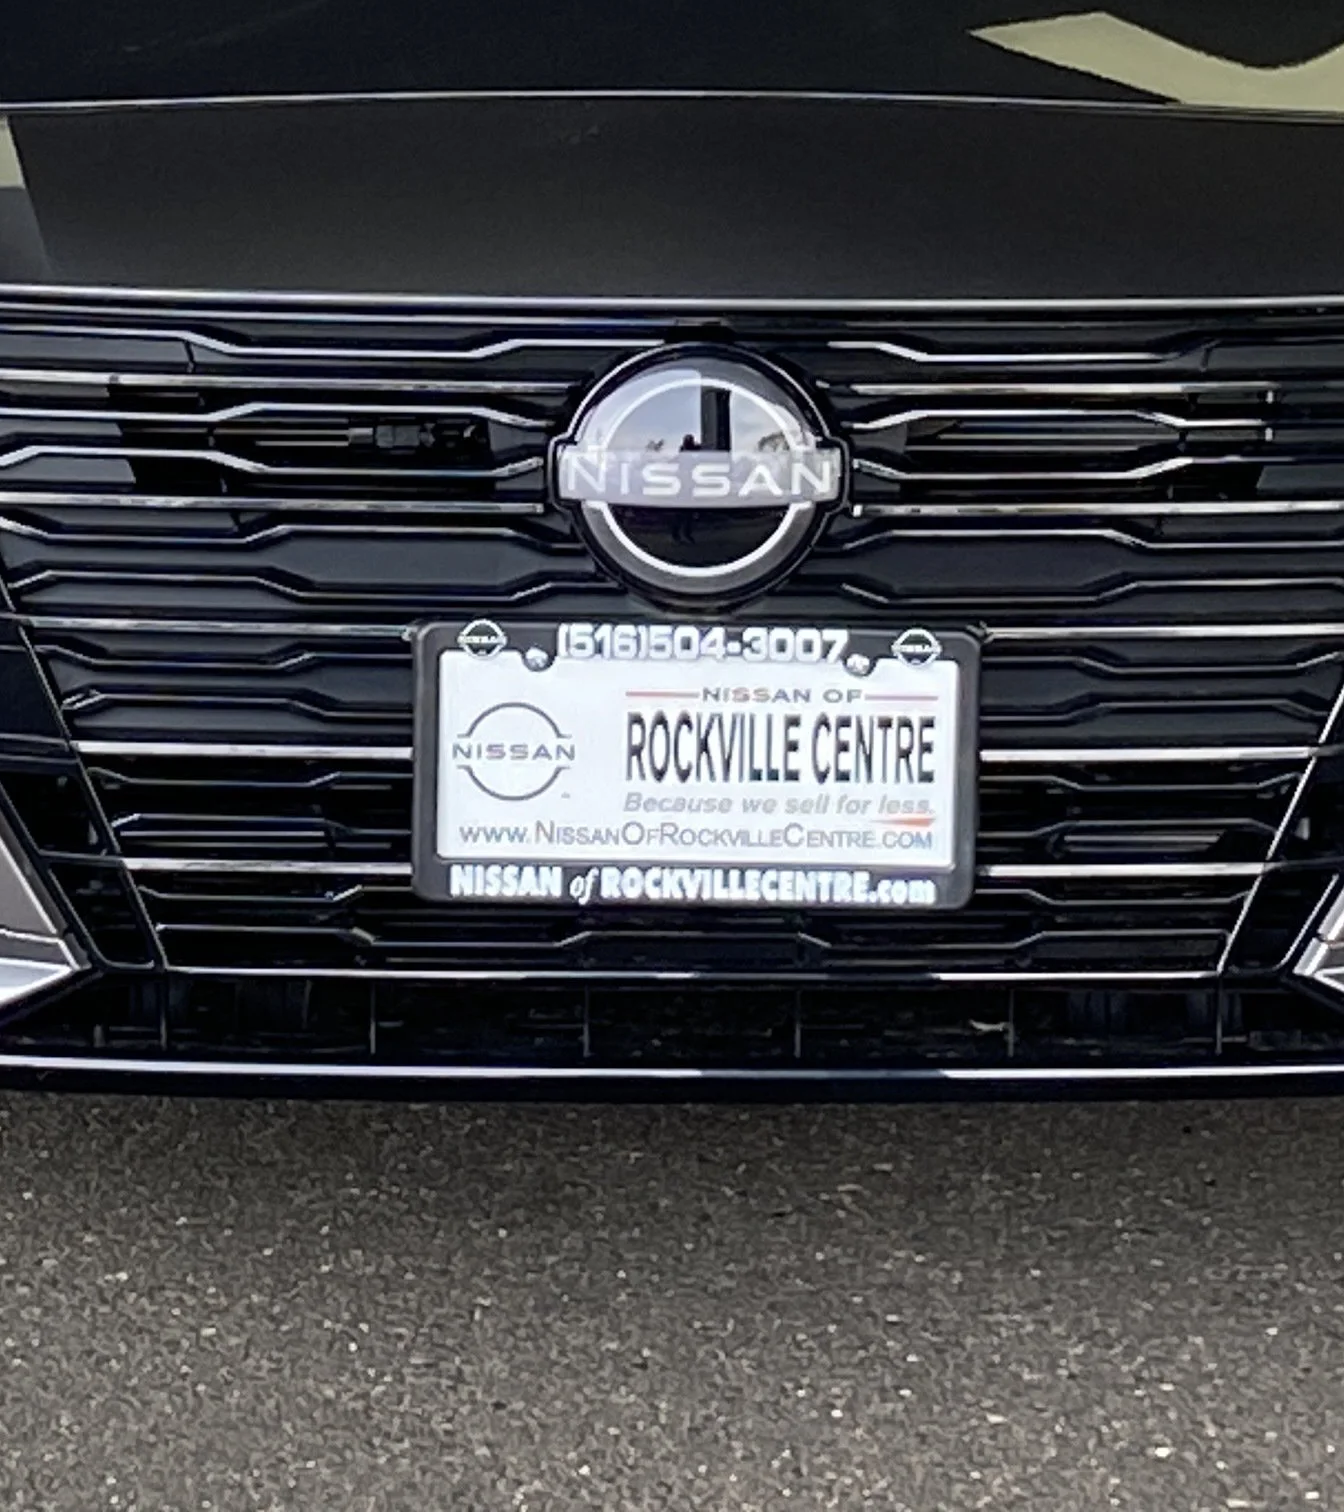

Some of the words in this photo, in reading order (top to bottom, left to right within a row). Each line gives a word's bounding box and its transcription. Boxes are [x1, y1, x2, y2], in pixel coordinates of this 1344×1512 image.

[567, 455, 831, 498] NISSAN
[558, 622, 849, 663] (516)504-3007
[702, 688, 811, 704] NISSAN
[822, 688, 863, 704] OF
[452, 742, 576, 761] NISSAN
[626, 709, 802, 784] ROCKVILLE
[811, 712, 937, 785] CENTRE
[623, 791, 733, 814] Because
[742, 795, 778, 814] we
[784, 793, 830, 815] sell
[836, 795, 872, 815] for
[450, 864, 563, 897] NISSAN
[569, 867, 599, 906] of
[600, 866, 937, 904] ROCKVILLECENTRE.com
